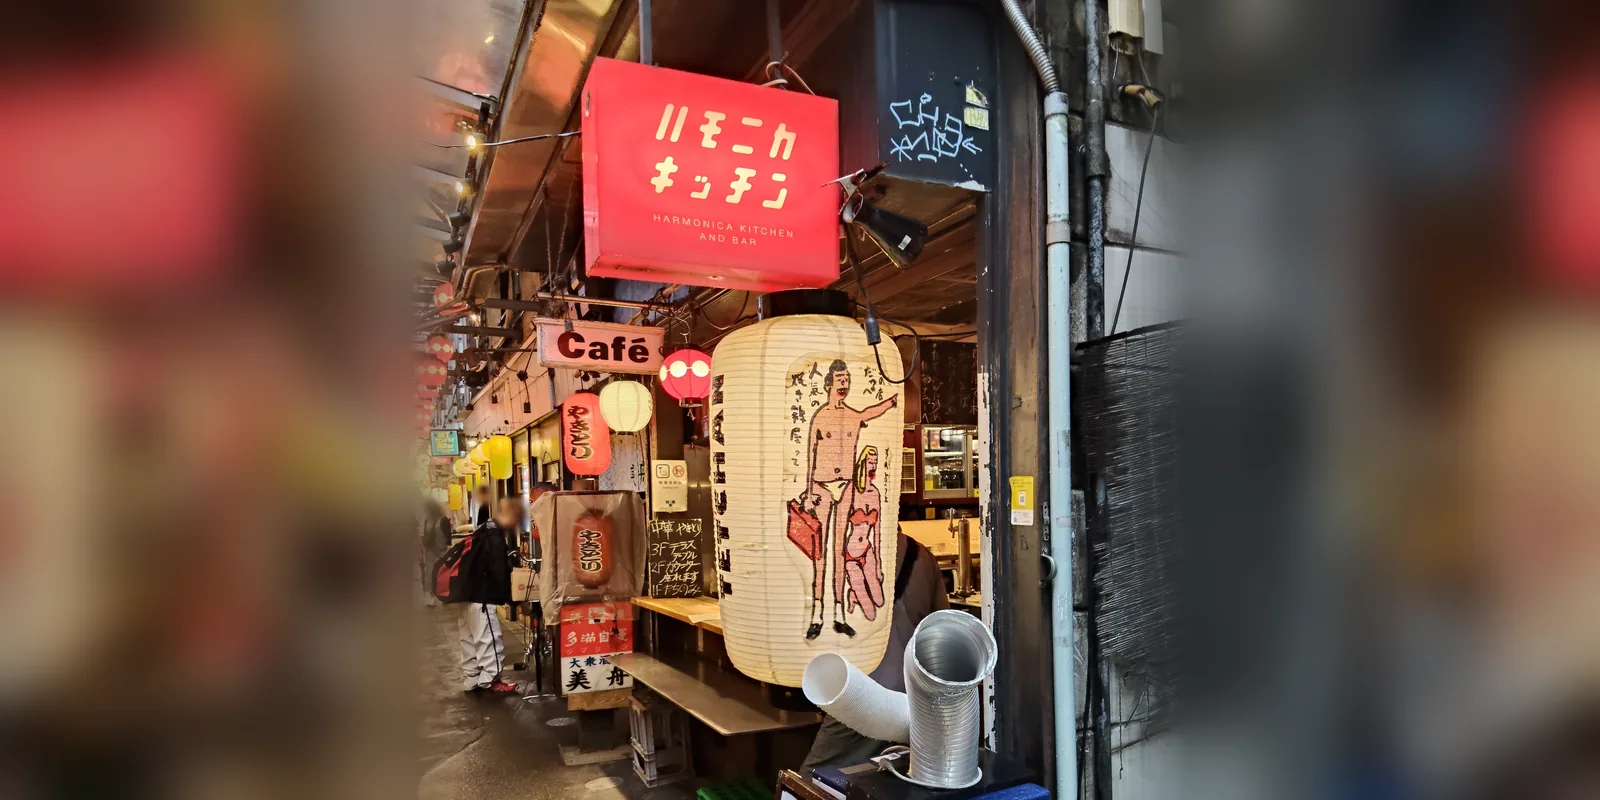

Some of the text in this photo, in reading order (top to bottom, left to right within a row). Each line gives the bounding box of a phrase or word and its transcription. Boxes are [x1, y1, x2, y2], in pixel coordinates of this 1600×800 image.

[655, 103, 797, 160] ハモニカ
[650, 156, 788, 209] キッチン
[653, 213, 794, 238] HARMONICA KITCHEN
[699, 232, 757, 246] AND BAR
[557, 331, 650, 363] Café
[712, 374, 733, 600] TETCHAN
[676, 522, 702, 538] やきとり
[578, 529, 603, 573] やきとり
[650, 540, 697, 556] 3F テラス
[651, 561, 665, 574] 2F
[652, 584, 663, 596] 1F
[570, 653, 624, 668] 大衆酒
